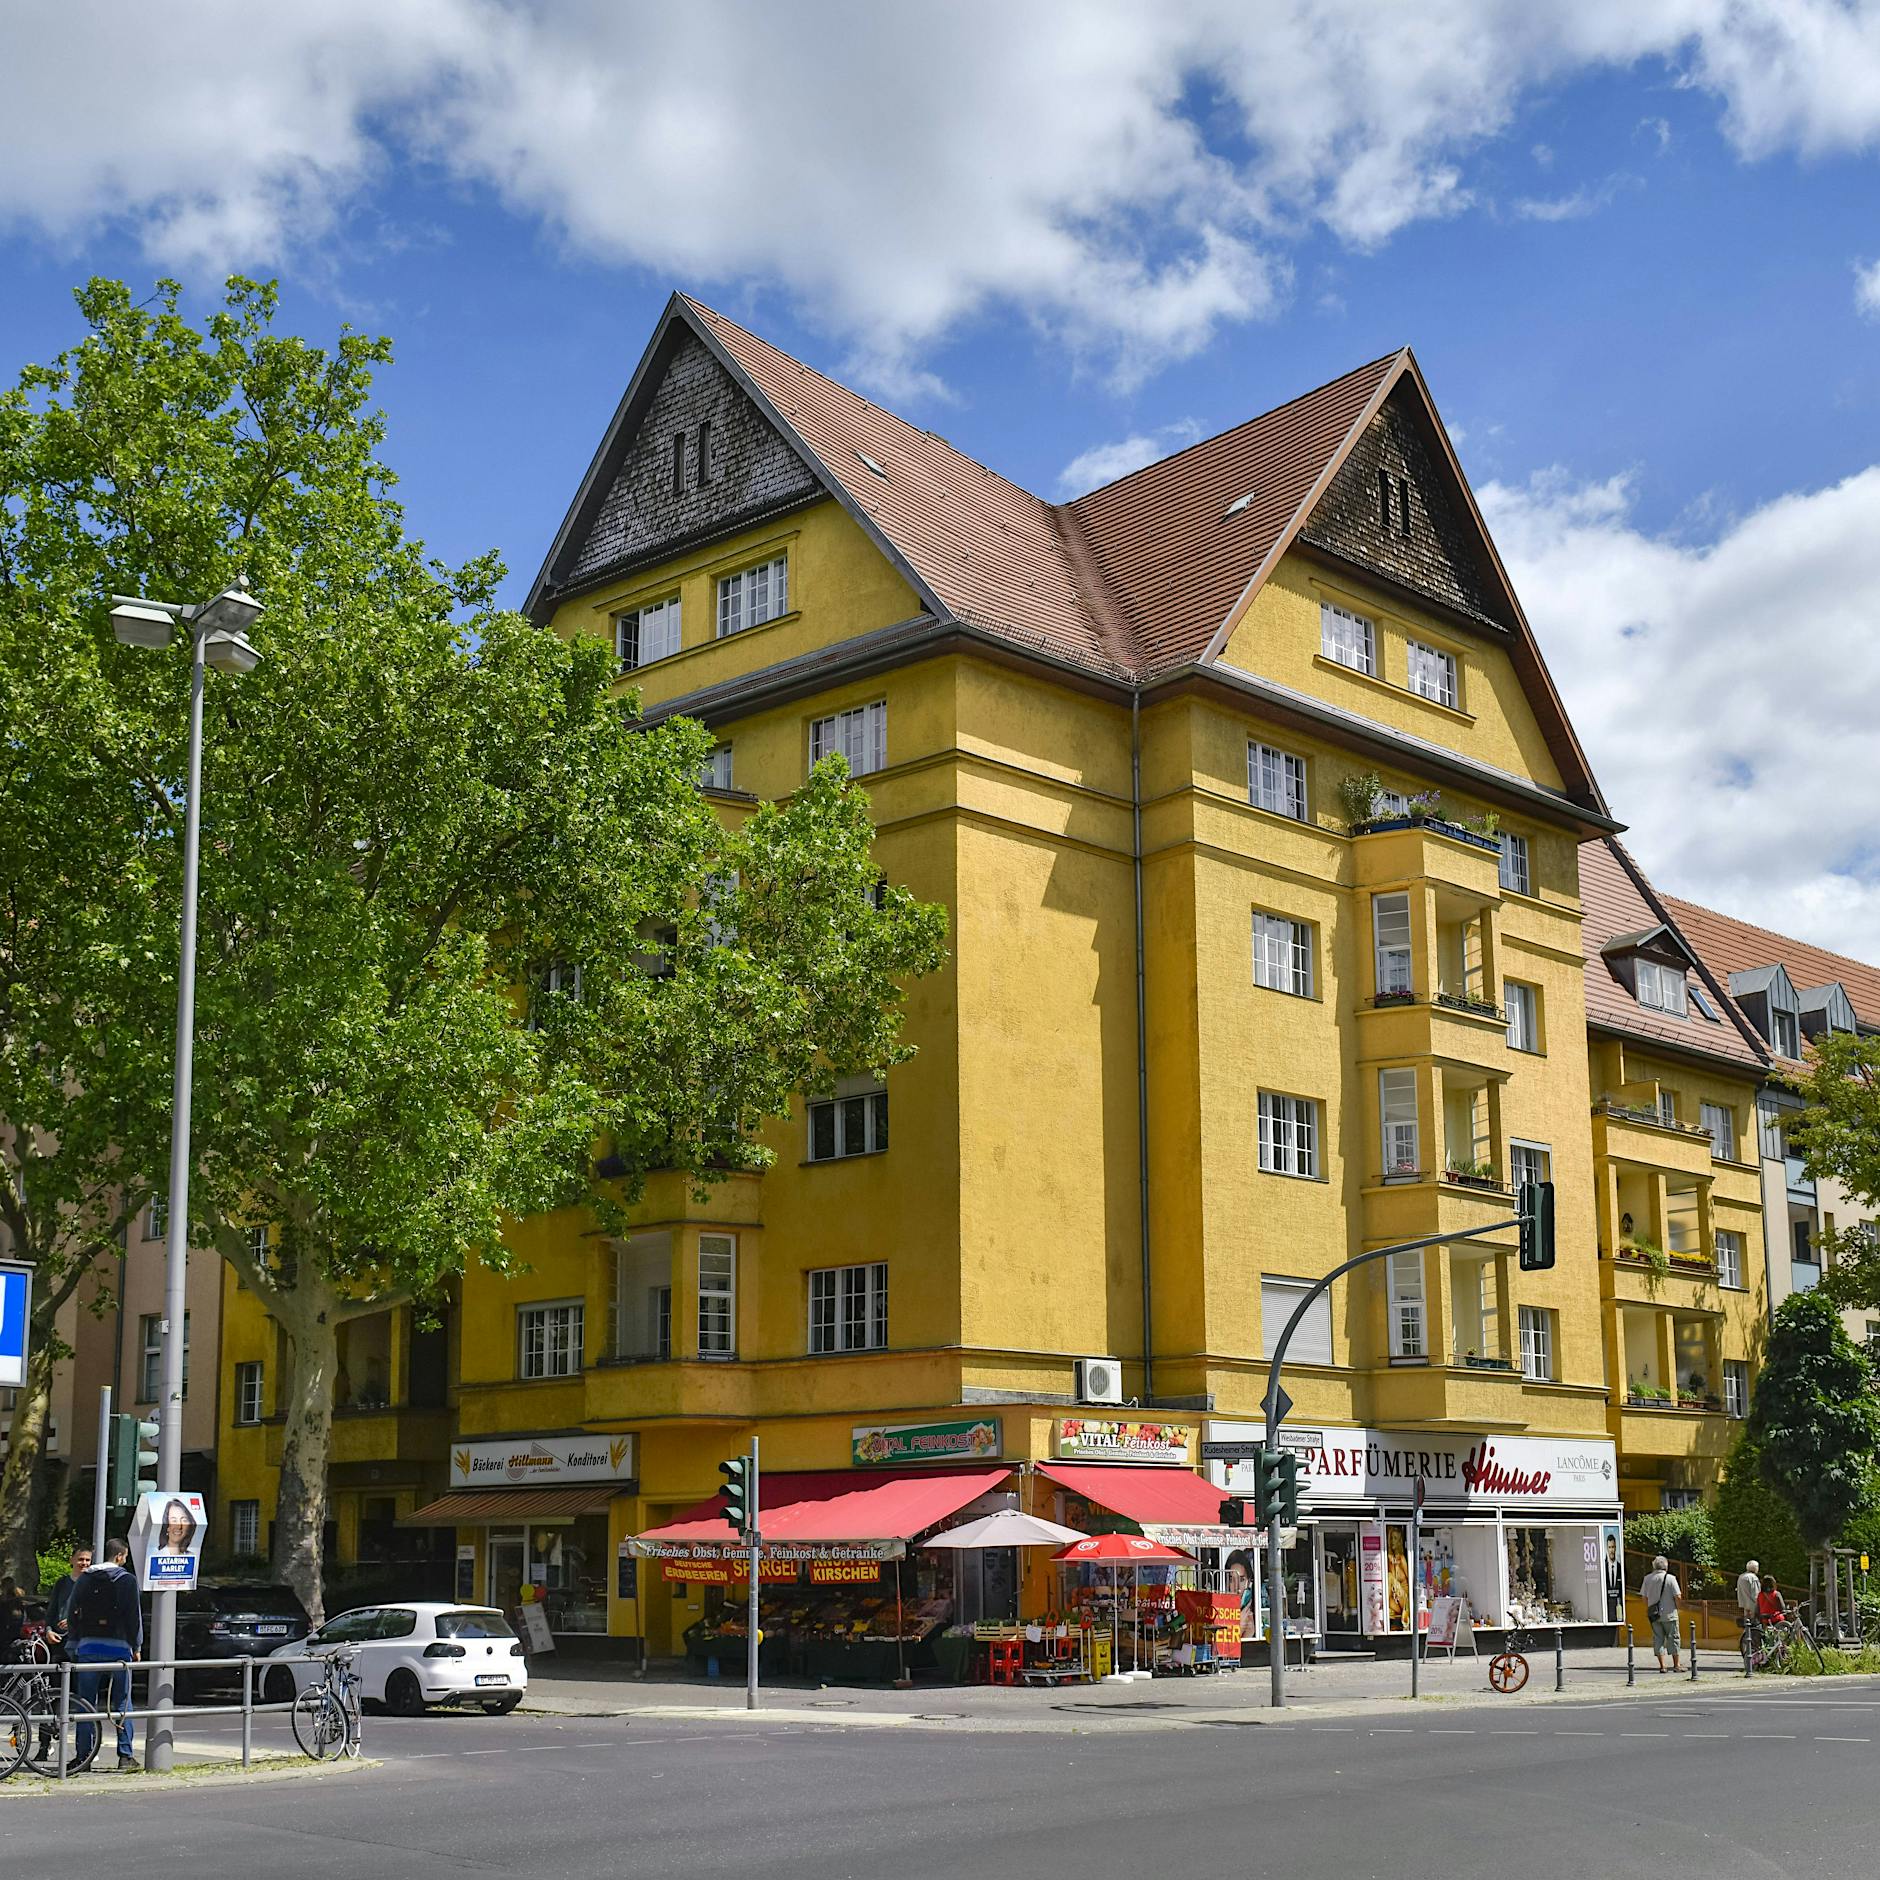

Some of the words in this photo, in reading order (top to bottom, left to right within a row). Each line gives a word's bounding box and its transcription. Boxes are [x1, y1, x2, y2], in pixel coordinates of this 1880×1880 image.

[911, 1433, 976, 1450] FEINKOST
[1079, 1433, 1120, 1447] VITAL
[1123, 1434, 1171, 1450] Feinkost
[1204, 1445, 1240, 1454] Rüdesheimer
[472, 1458, 505, 1472] Bäckerei
[508, 1454, 553, 1468] Hillmann
[567, 1451, 608, 1467] Konditorei
[1241, 1464, 1254, 1472] PAR
[1303, 1443, 1456, 1478] PARFÜMERIE
[1461, 1441, 1551, 1494] Himmer
[1557, 1455, 1599, 1470] LANCÔME
[645, 1545, 689, 1558] Frisches
[692, 1546, 720, 1559] Obst,
[722, 1546, 766, 1559] Geme,
[769, 1546, 816, 1559] Feinkost
[819, 1546, 829, 1559] &
[831, 1546, 884, 1559] Getränke
[1583, 1542, 1597, 1562] 80
[161, 1565, 185, 1573] BARLEY
[674, 1560, 713, 1569] DEUTSCHE
[733, 1560, 797, 1577] SPRGEL
[1364, 1562, 1380, 1571] 20%
[1584, 1563, 1598, 1571] Jahre
[665, 1566, 728, 1581] ERDBEEREN
[813, 1566, 878, 1581] KIRSCHEN
[1136, 1598, 1176, 1610] Feinkos
